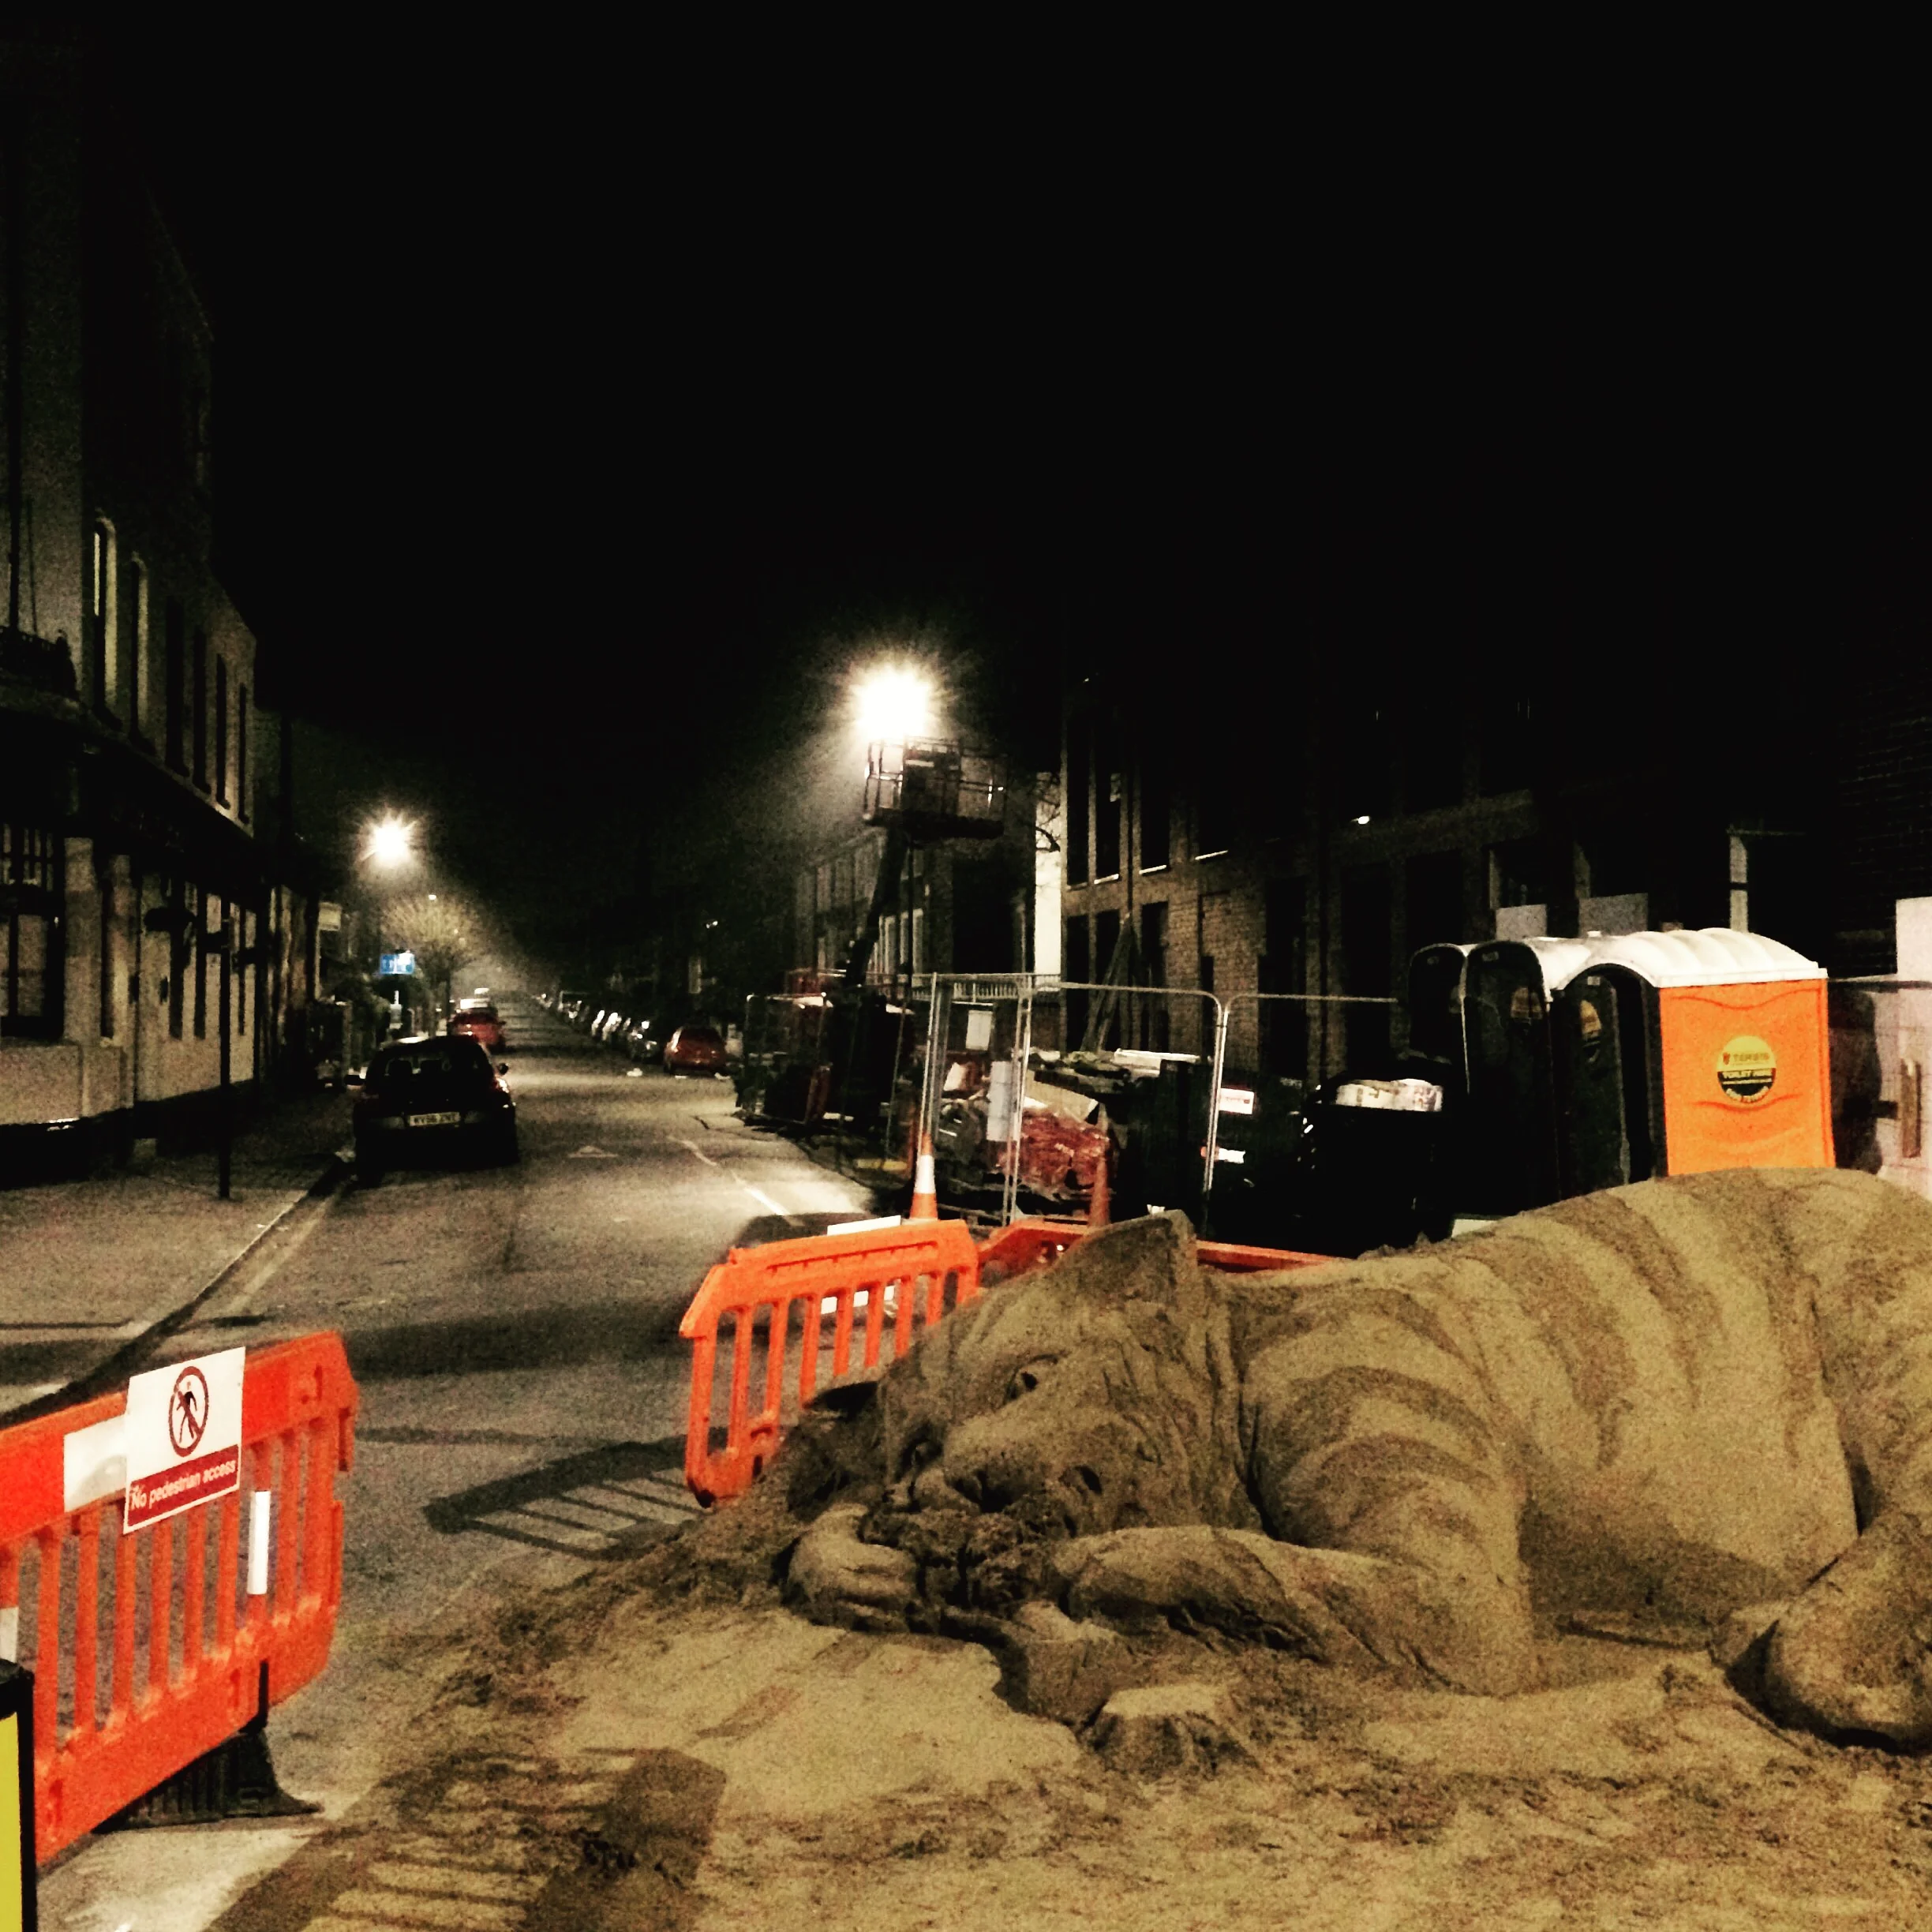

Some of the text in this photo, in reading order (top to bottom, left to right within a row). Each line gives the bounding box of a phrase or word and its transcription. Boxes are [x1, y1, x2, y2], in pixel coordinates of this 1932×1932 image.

[131, 1460, 236, 1511] No pedestrian access
